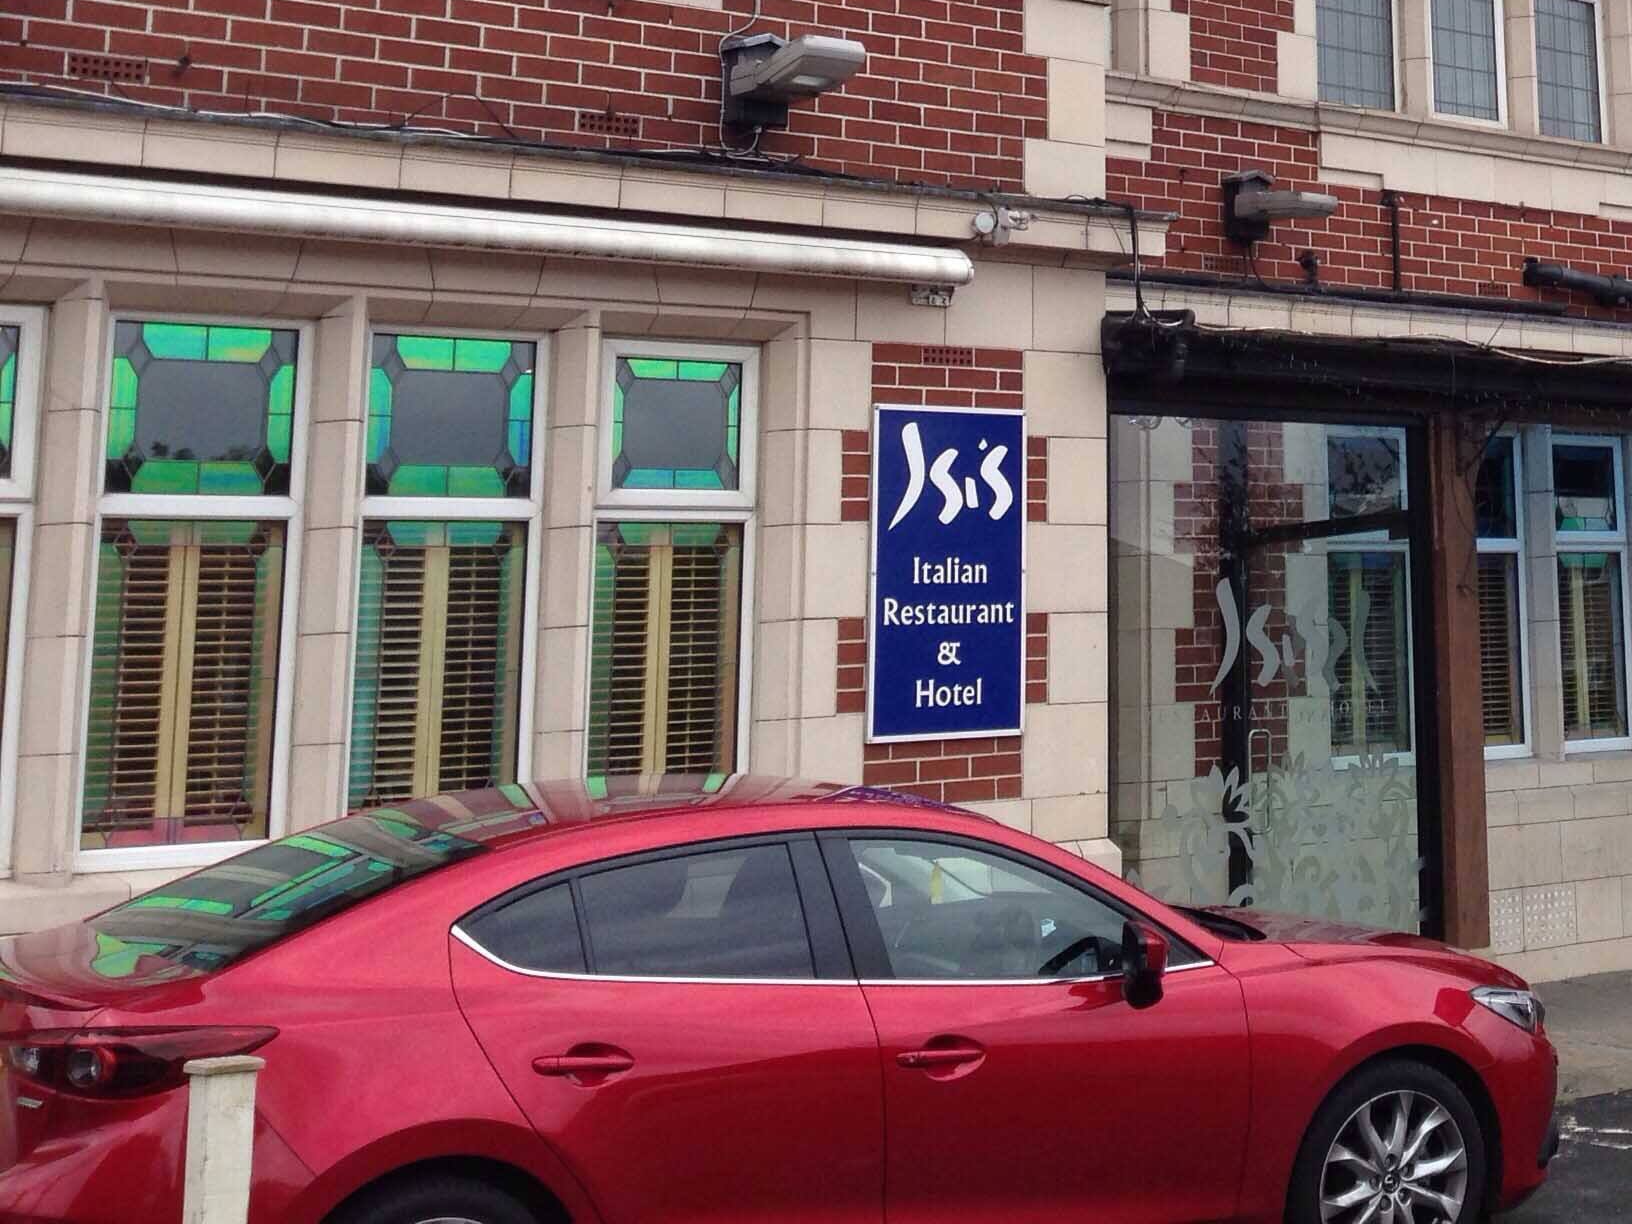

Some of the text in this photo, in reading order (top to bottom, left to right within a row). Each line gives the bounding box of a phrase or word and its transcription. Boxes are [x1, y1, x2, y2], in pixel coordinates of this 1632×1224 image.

[913, 557, 988, 584] Italian
[883, 598, 1015, 626] Restaurant
[937, 642, 962, 665] &
[915, 679, 983, 708] Hotel
